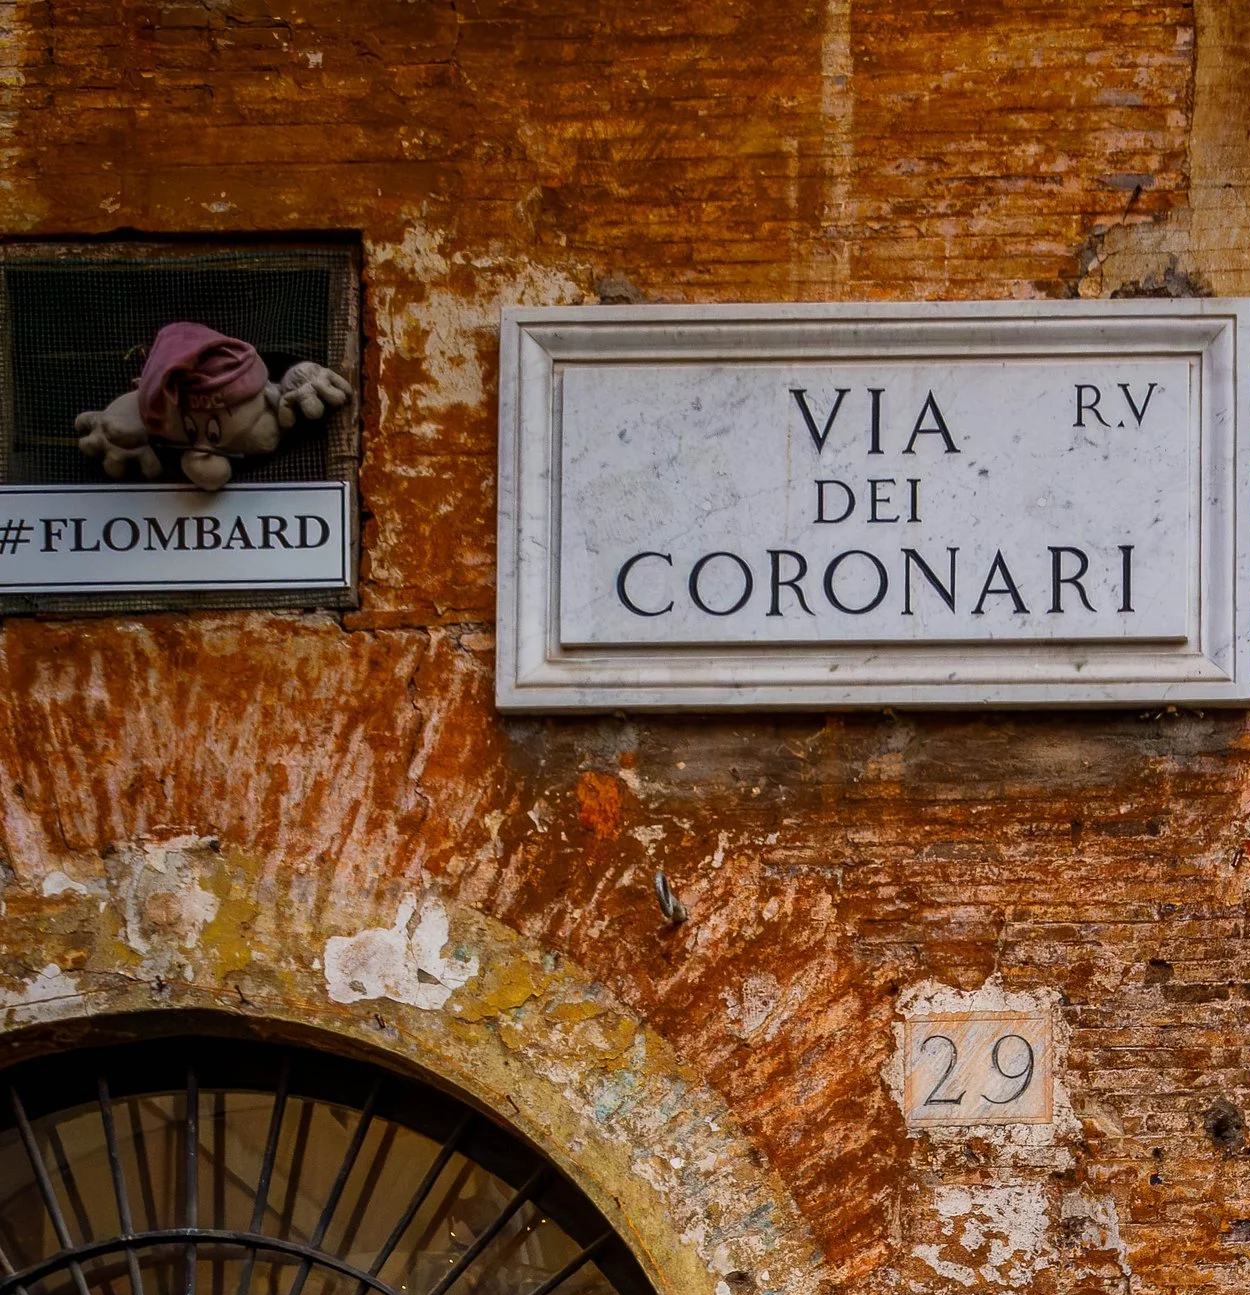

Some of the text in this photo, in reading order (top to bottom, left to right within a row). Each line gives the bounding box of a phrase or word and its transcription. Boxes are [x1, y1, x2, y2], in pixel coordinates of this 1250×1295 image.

[789, 387, 962, 455] VIA
[0, 514, 331, 554] #FLOMBARD
[812, 478, 922, 524] DEI
[615, 544, 1136, 618] CORONARI
[919, 1033, 1035, 1107] 29
